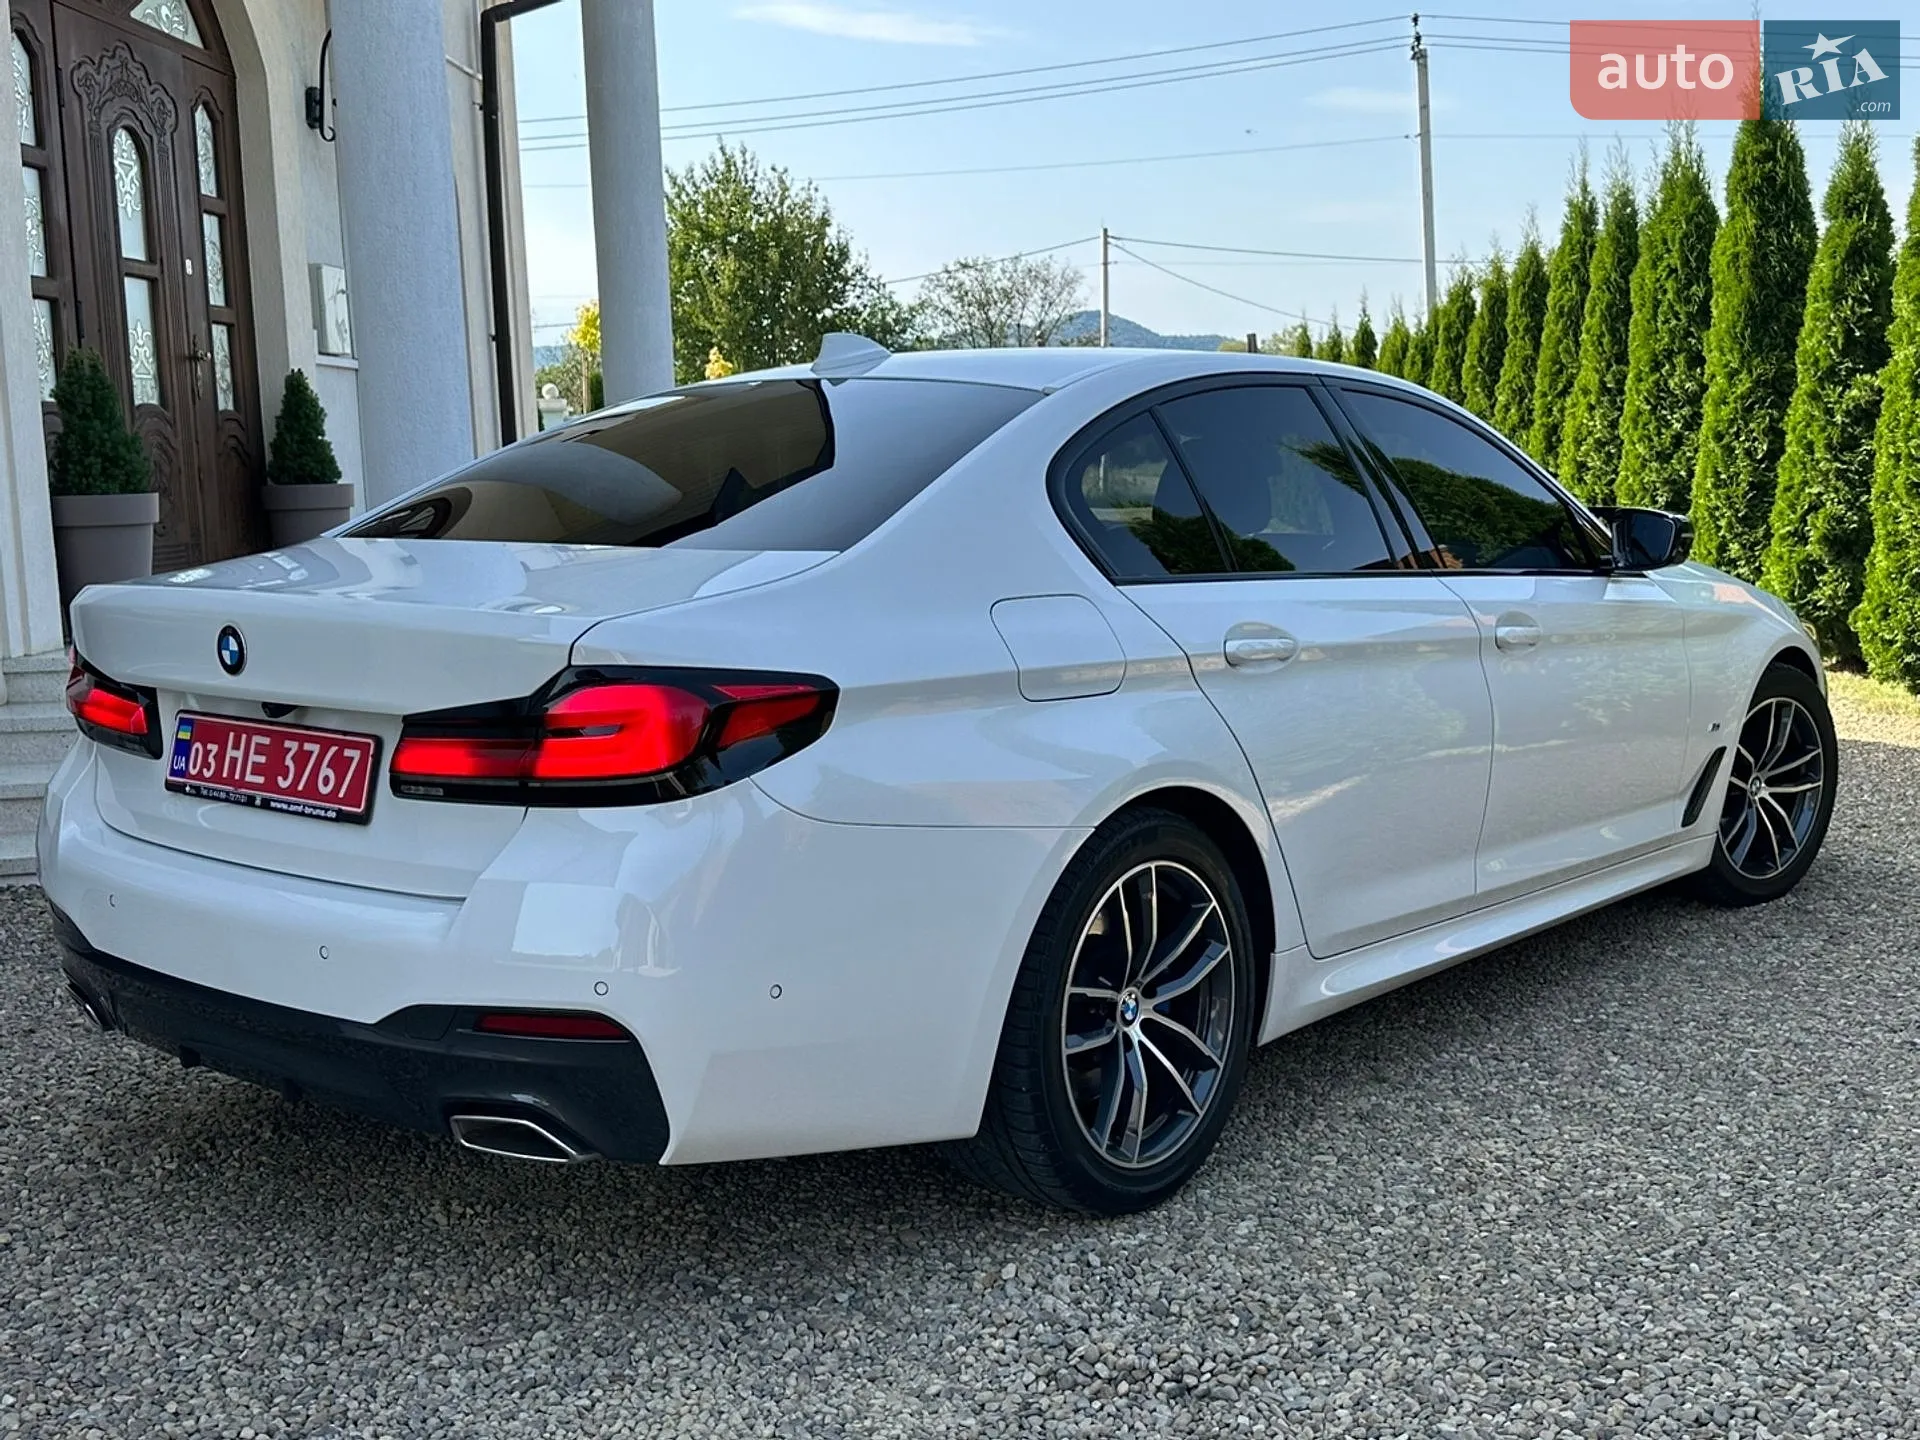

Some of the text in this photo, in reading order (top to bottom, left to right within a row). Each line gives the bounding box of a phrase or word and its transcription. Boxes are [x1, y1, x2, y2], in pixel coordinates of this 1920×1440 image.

[173, 755, 186, 771] UA
[188, 731, 361, 799] 03 HE 3767
